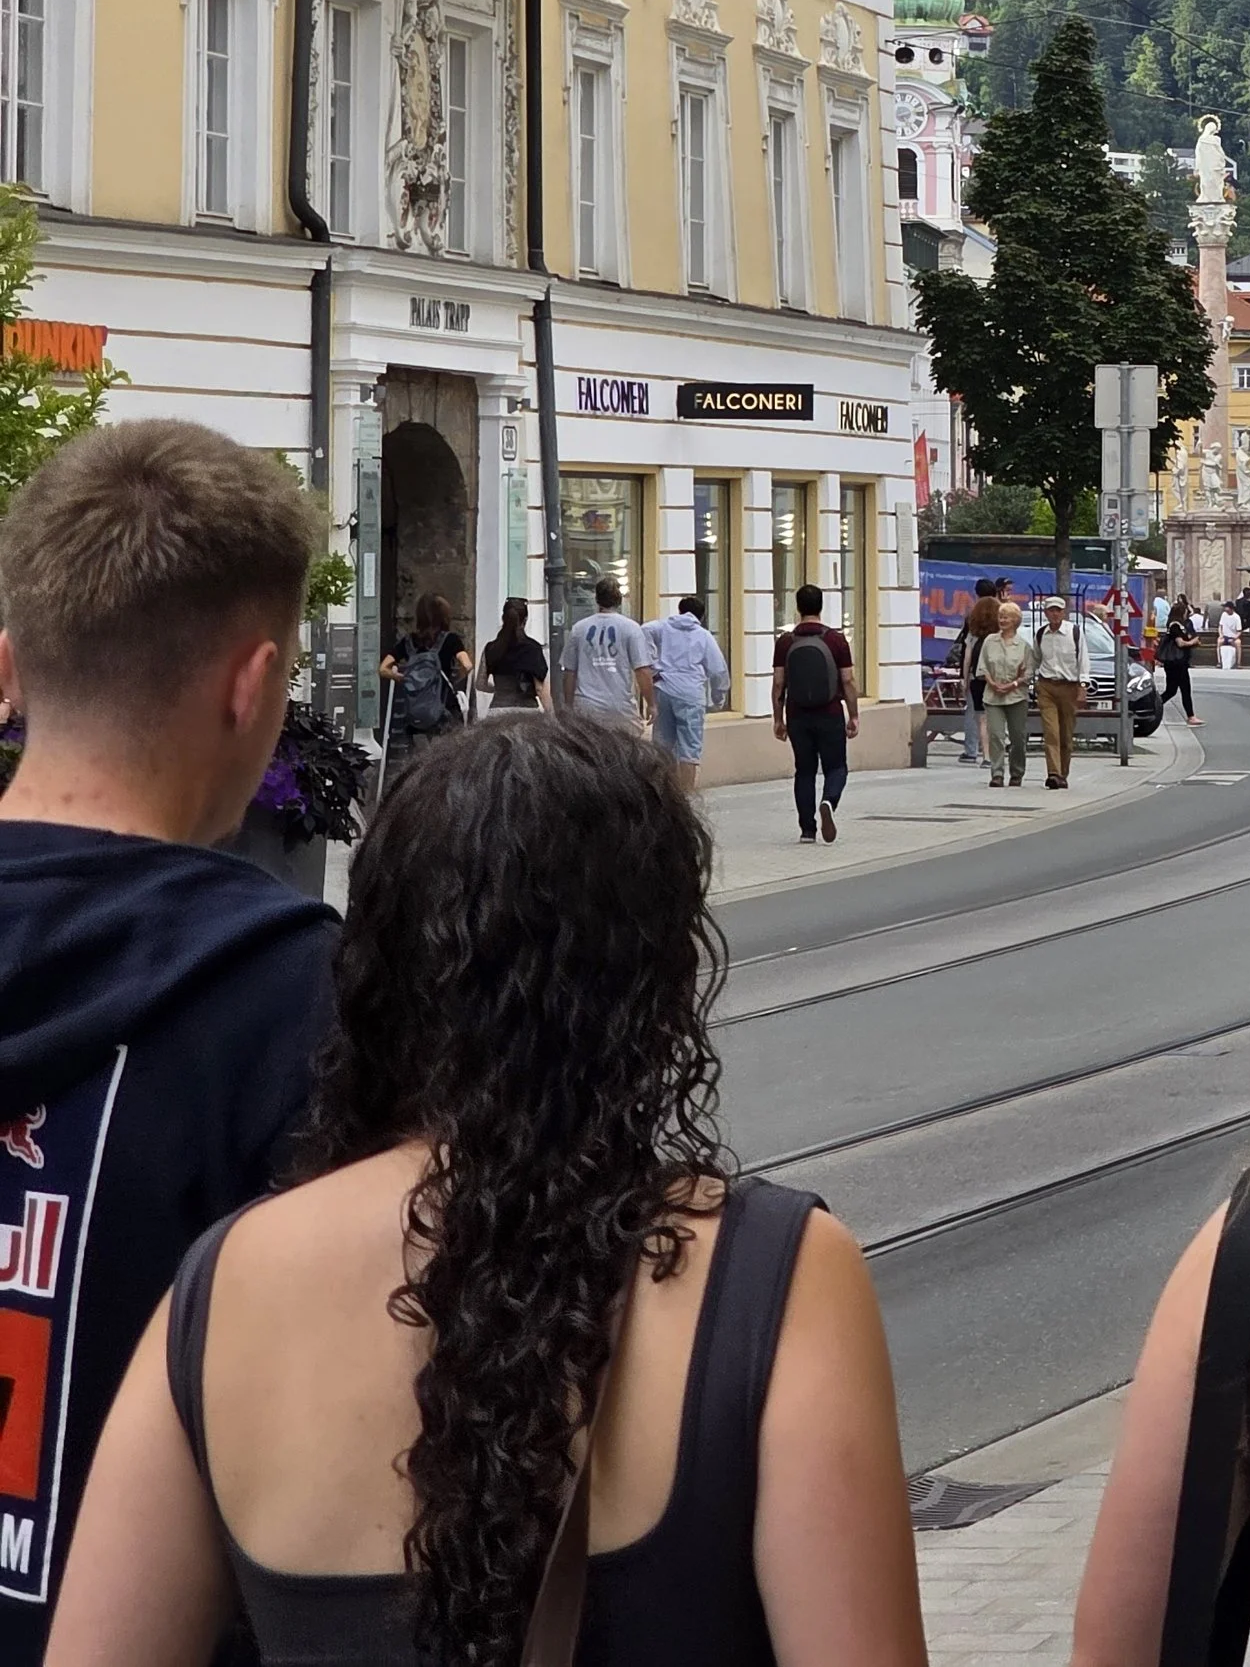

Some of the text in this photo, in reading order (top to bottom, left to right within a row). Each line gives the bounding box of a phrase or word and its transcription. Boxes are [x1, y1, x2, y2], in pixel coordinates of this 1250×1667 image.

[410, 296, 471, 333] PALAIS TRAPP
[577, 376, 649, 416] FALCONERI
[694, 392, 802, 411] FALCONERI
